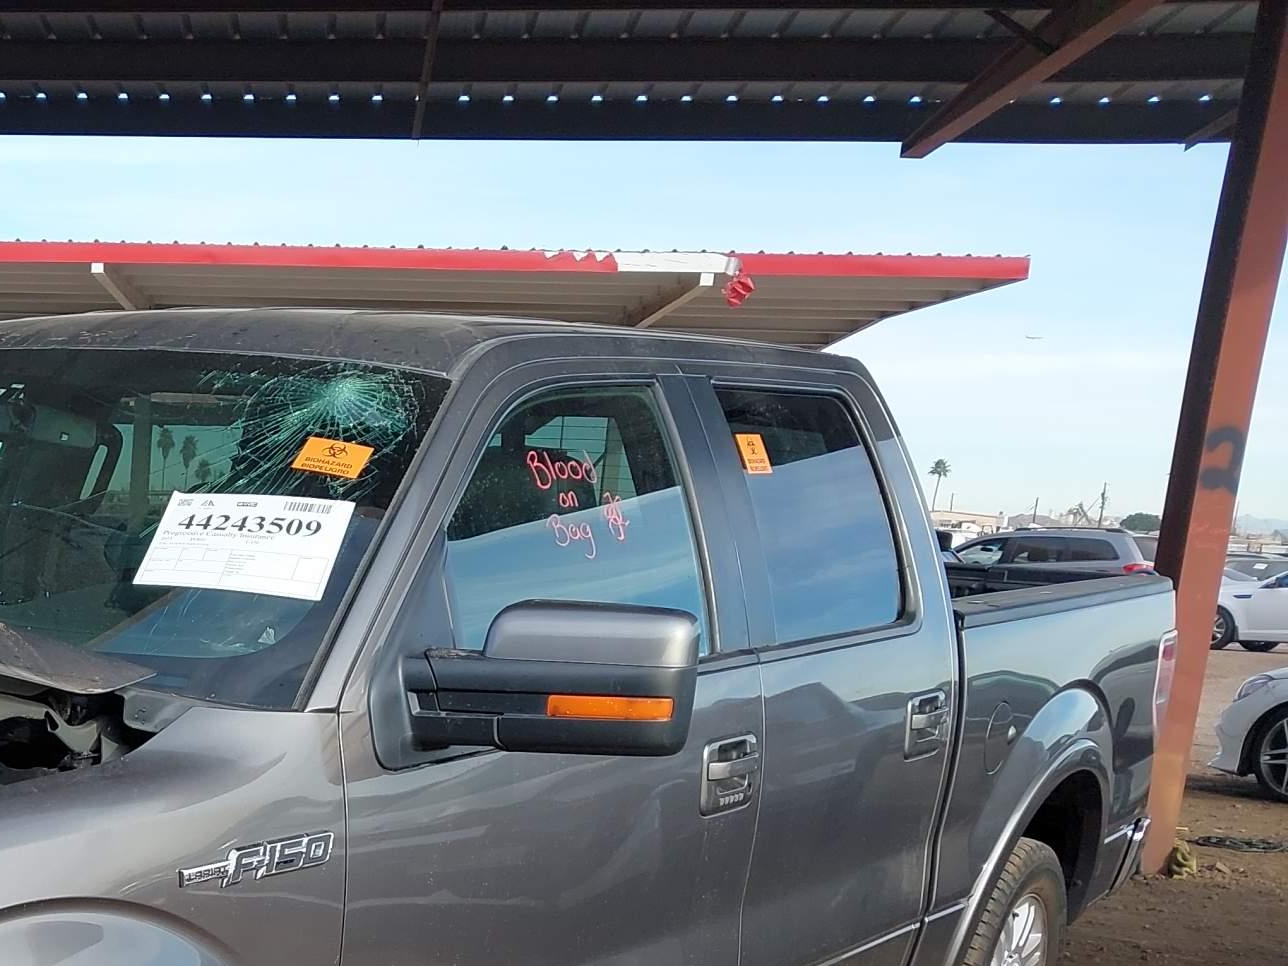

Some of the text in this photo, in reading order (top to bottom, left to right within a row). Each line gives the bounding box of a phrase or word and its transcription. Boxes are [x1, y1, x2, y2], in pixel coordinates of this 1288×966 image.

[304, 456, 353, 469] BIOHAZARD
[527, 449, 598, 490] Blood
[558, 490, 579, 508] on
[177, 513, 322, 537] 44243509
[546, 513, 596, 559] Bag
